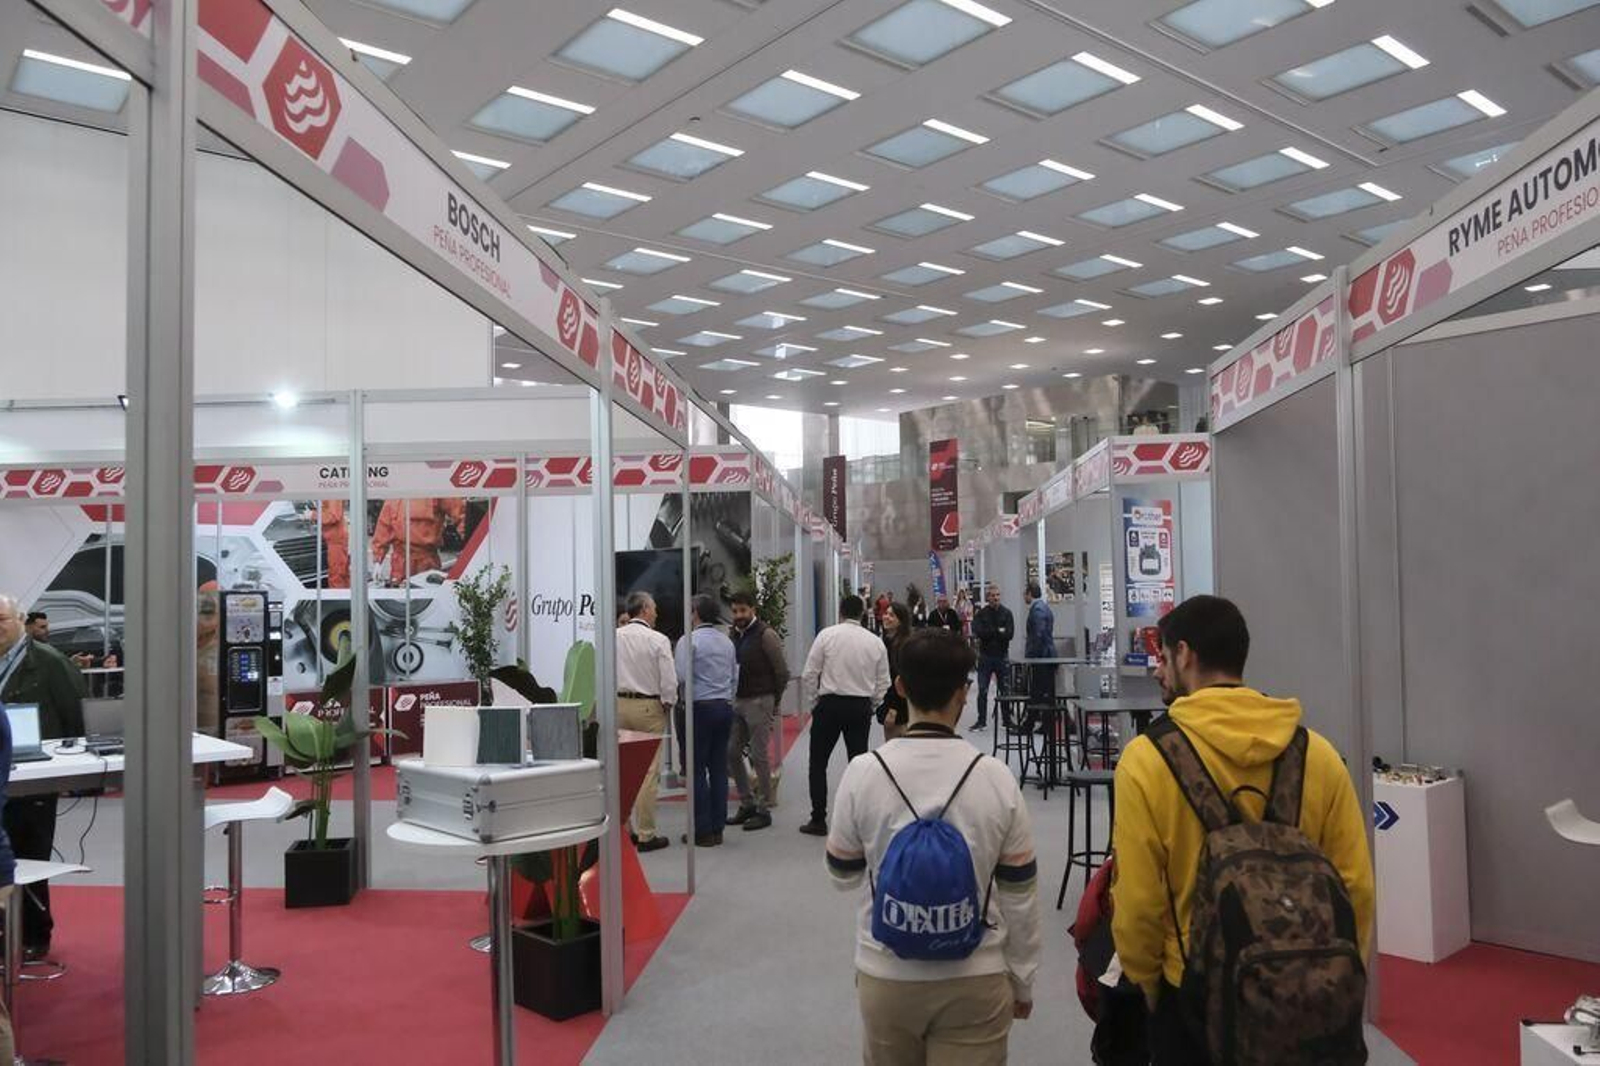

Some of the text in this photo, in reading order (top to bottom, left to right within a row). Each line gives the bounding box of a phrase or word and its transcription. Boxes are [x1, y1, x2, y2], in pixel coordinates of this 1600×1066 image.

[1450, 137, 1600, 257] RYME AUTOM
[447, 192, 500, 263] BOSCH
[1498, 226, 1529, 256] PEÑA
[531, 594, 573, 623] Grupo
